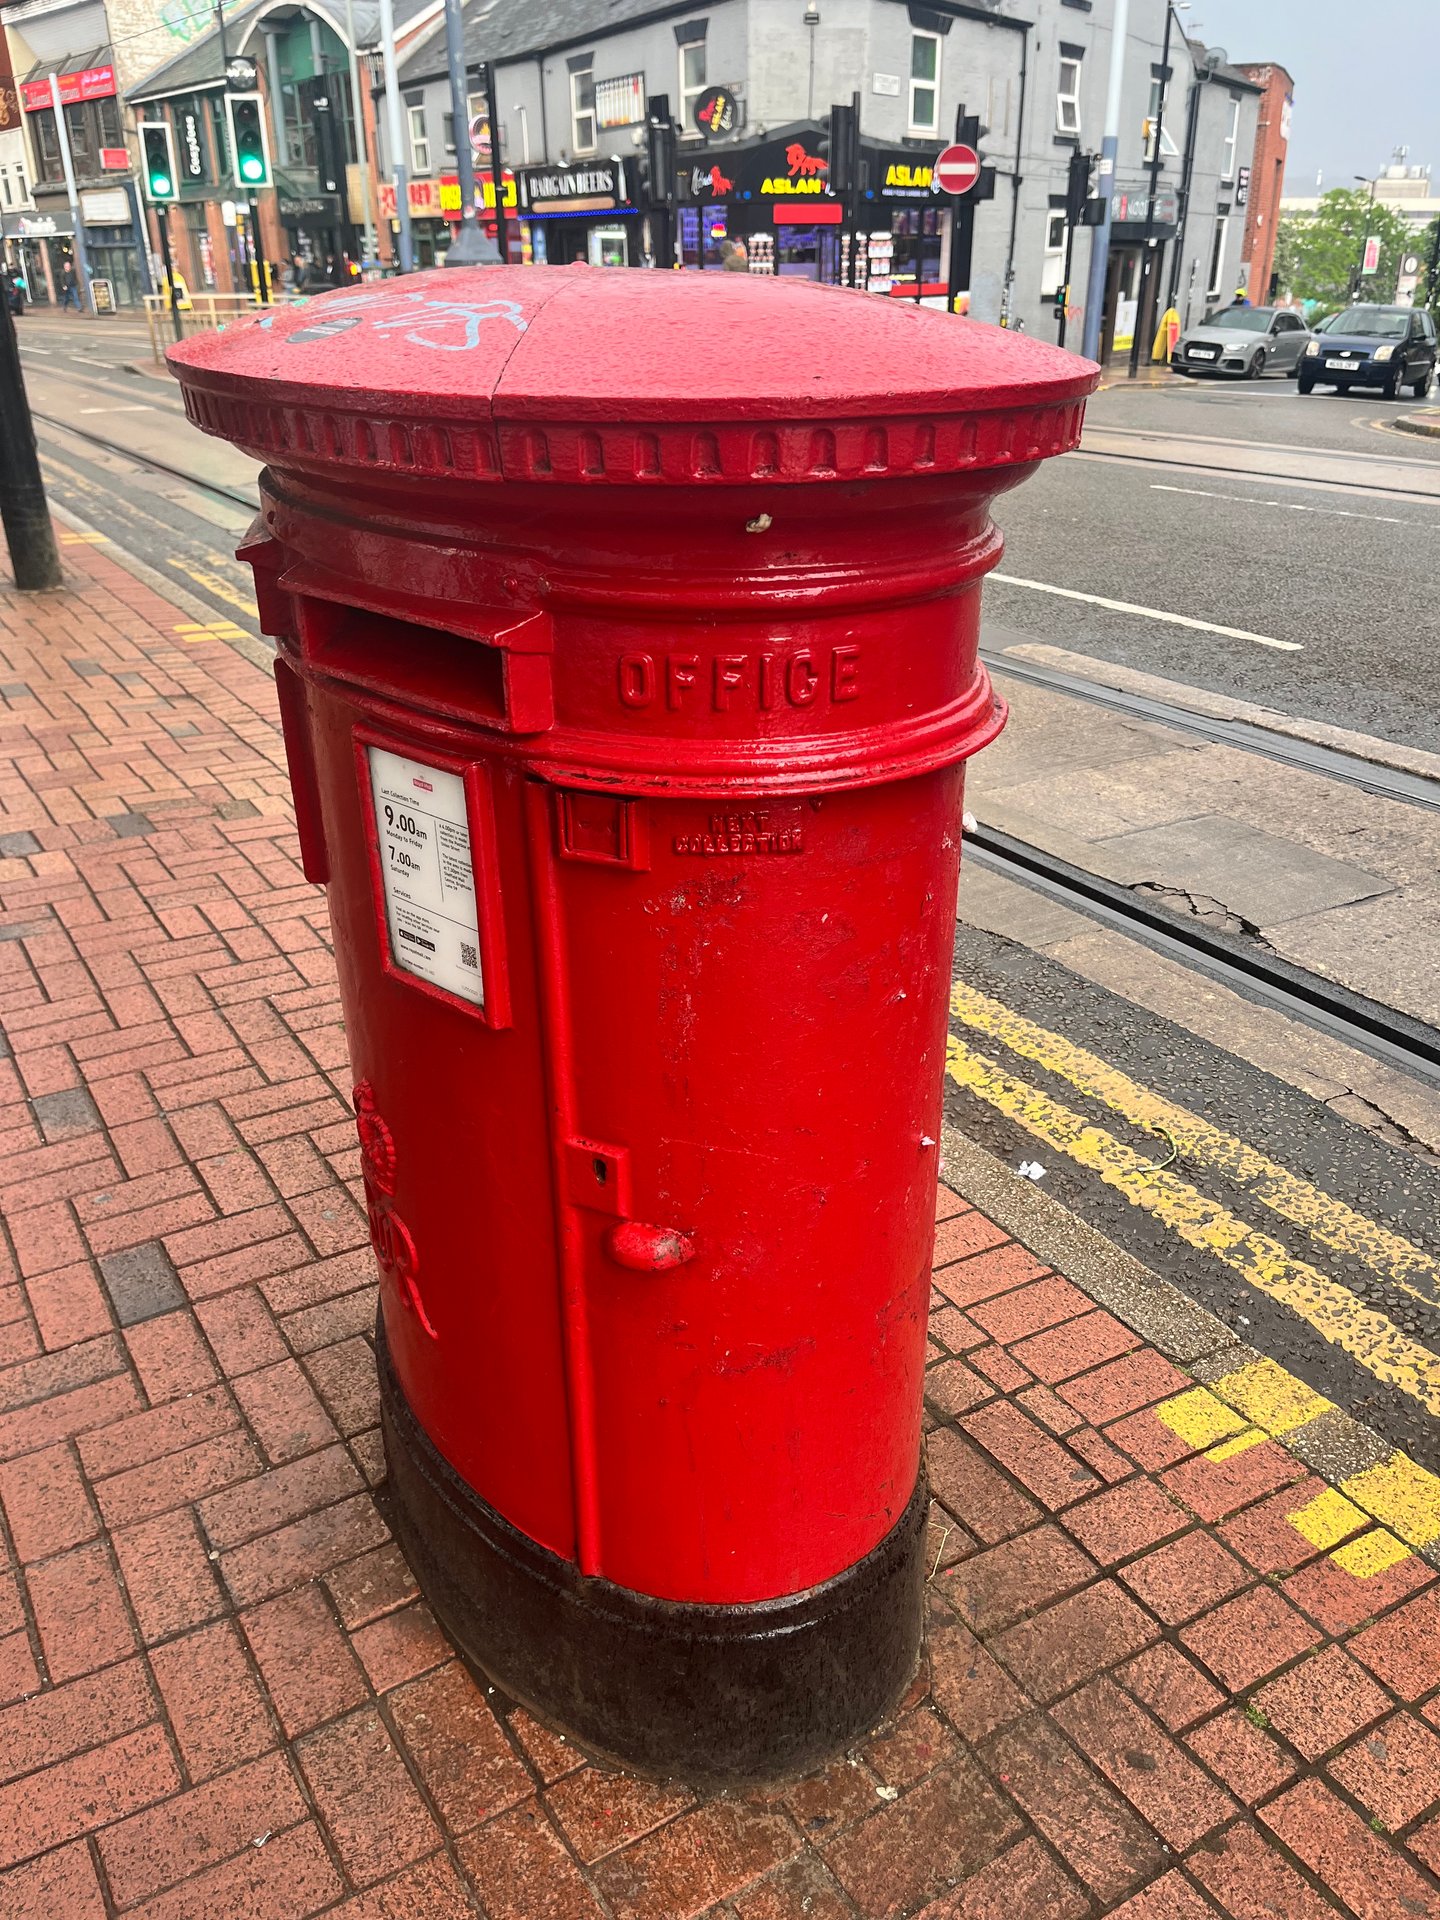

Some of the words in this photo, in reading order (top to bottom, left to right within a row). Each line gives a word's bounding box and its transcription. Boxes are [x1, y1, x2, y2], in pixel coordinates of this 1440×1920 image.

[530, 174, 577, 198] BARGAIN
[577, 169, 614, 195] BEERS
[760, 178, 823, 194] ASLAN
[886, 164, 933, 187] ASLAN
[617, 645, 862, 713] OFFICE
[390, 791, 409, 802] Collection
[409, 798, 419, 806] Time
[385, 805, 426, 839] 9.00am
[708, 811, 770, 834] NEXT
[386, 830, 402, 841] Monday
[409, 838, 422, 849] Friday
[673, 829, 803, 857] COLLECTION
[389, 845, 420, 870] 7.00am
[391, 865, 409, 877] Saturday
[394, 887, 411, 899] Services
